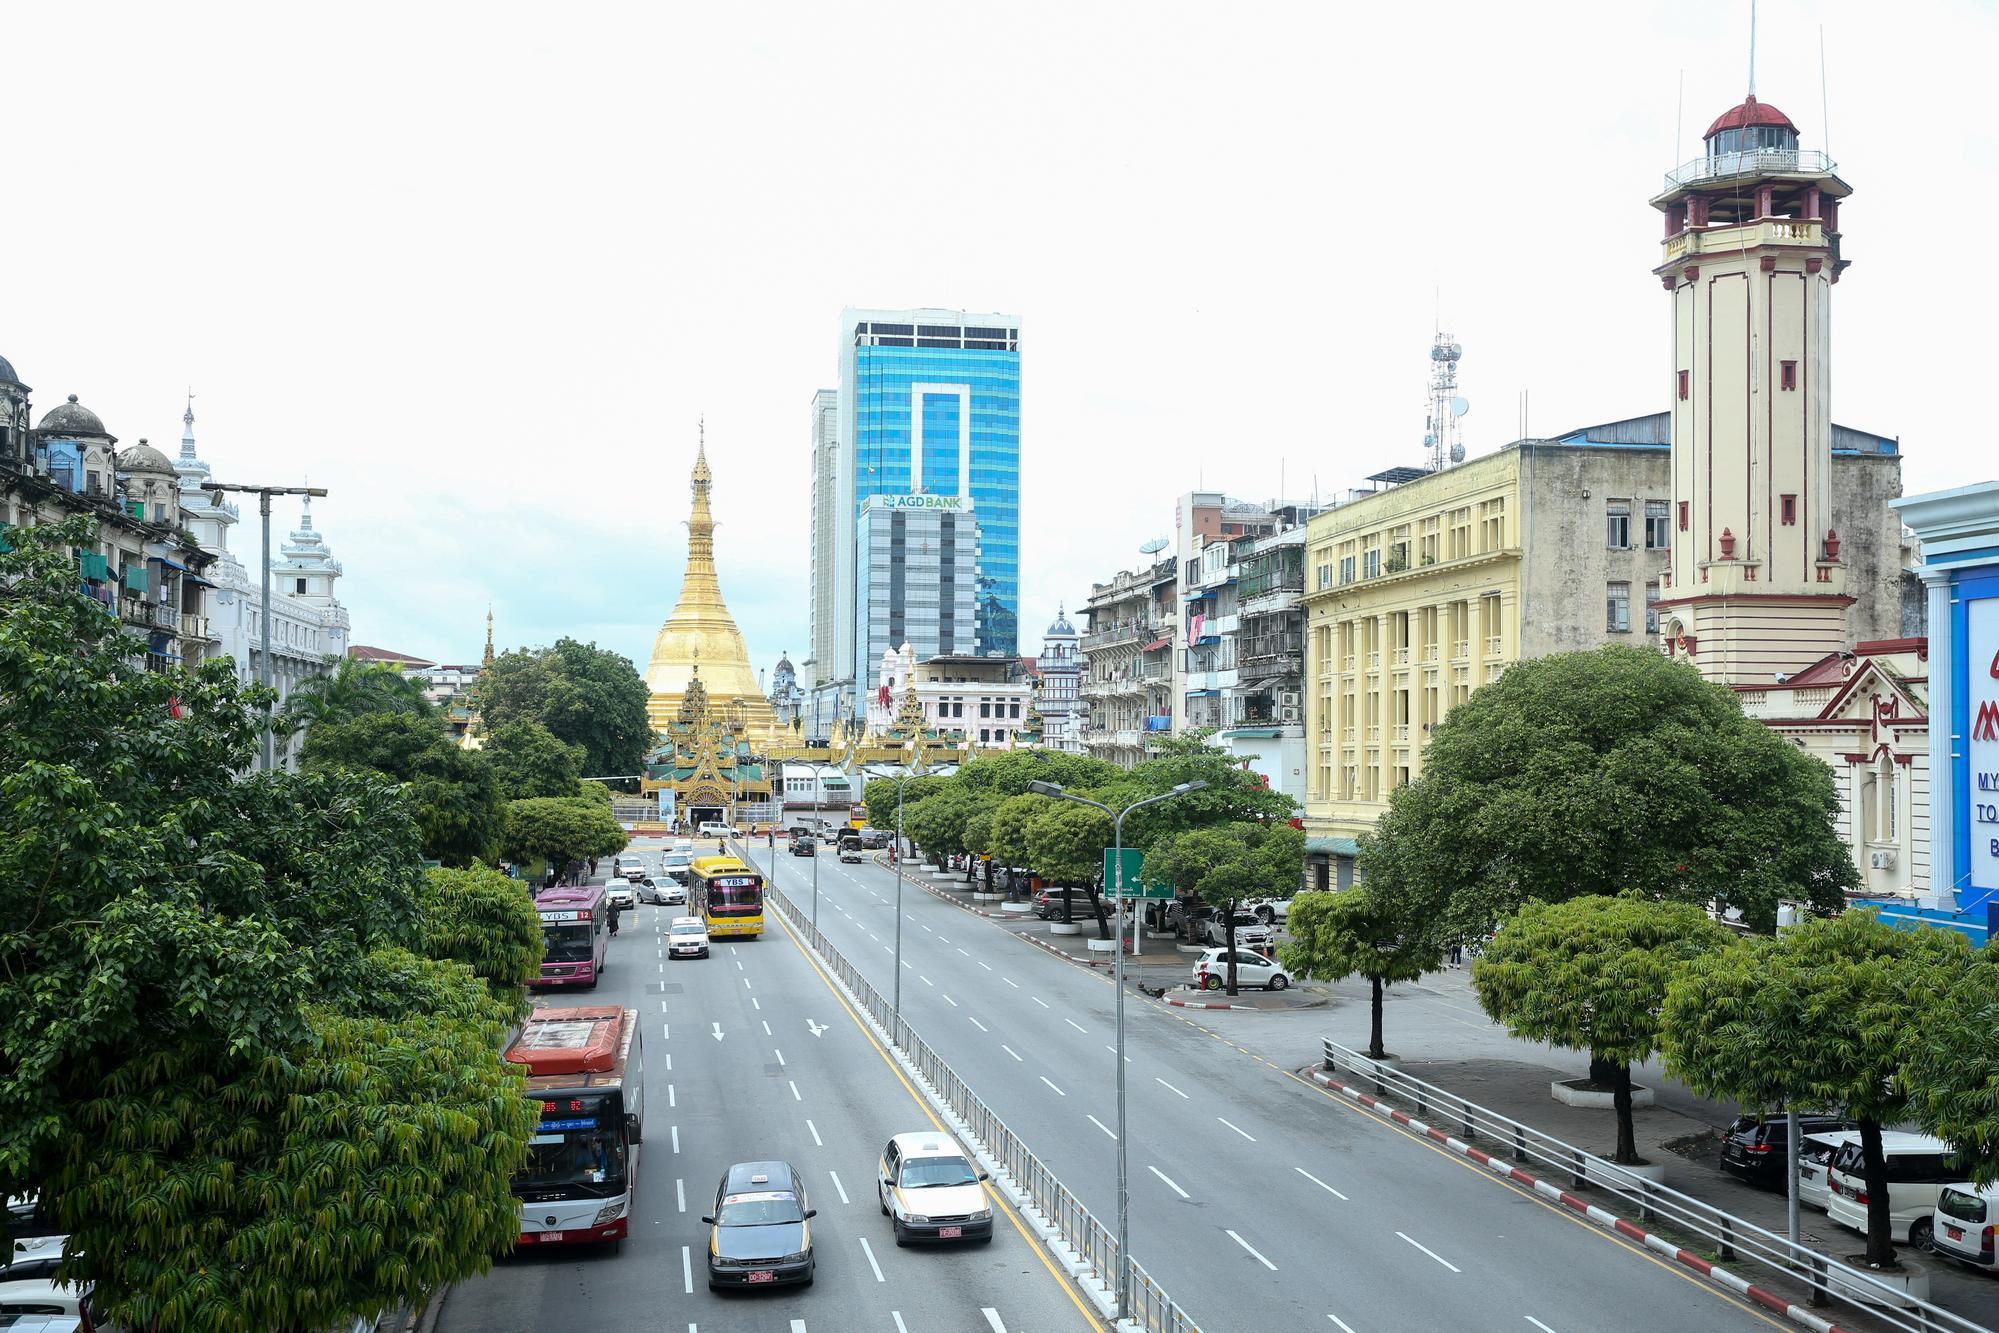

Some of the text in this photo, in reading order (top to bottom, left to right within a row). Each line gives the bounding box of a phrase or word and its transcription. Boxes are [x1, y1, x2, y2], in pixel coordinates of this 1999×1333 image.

[898, 496, 960, 508] AGD BANK
[545, 911, 589, 920] YBS 12
